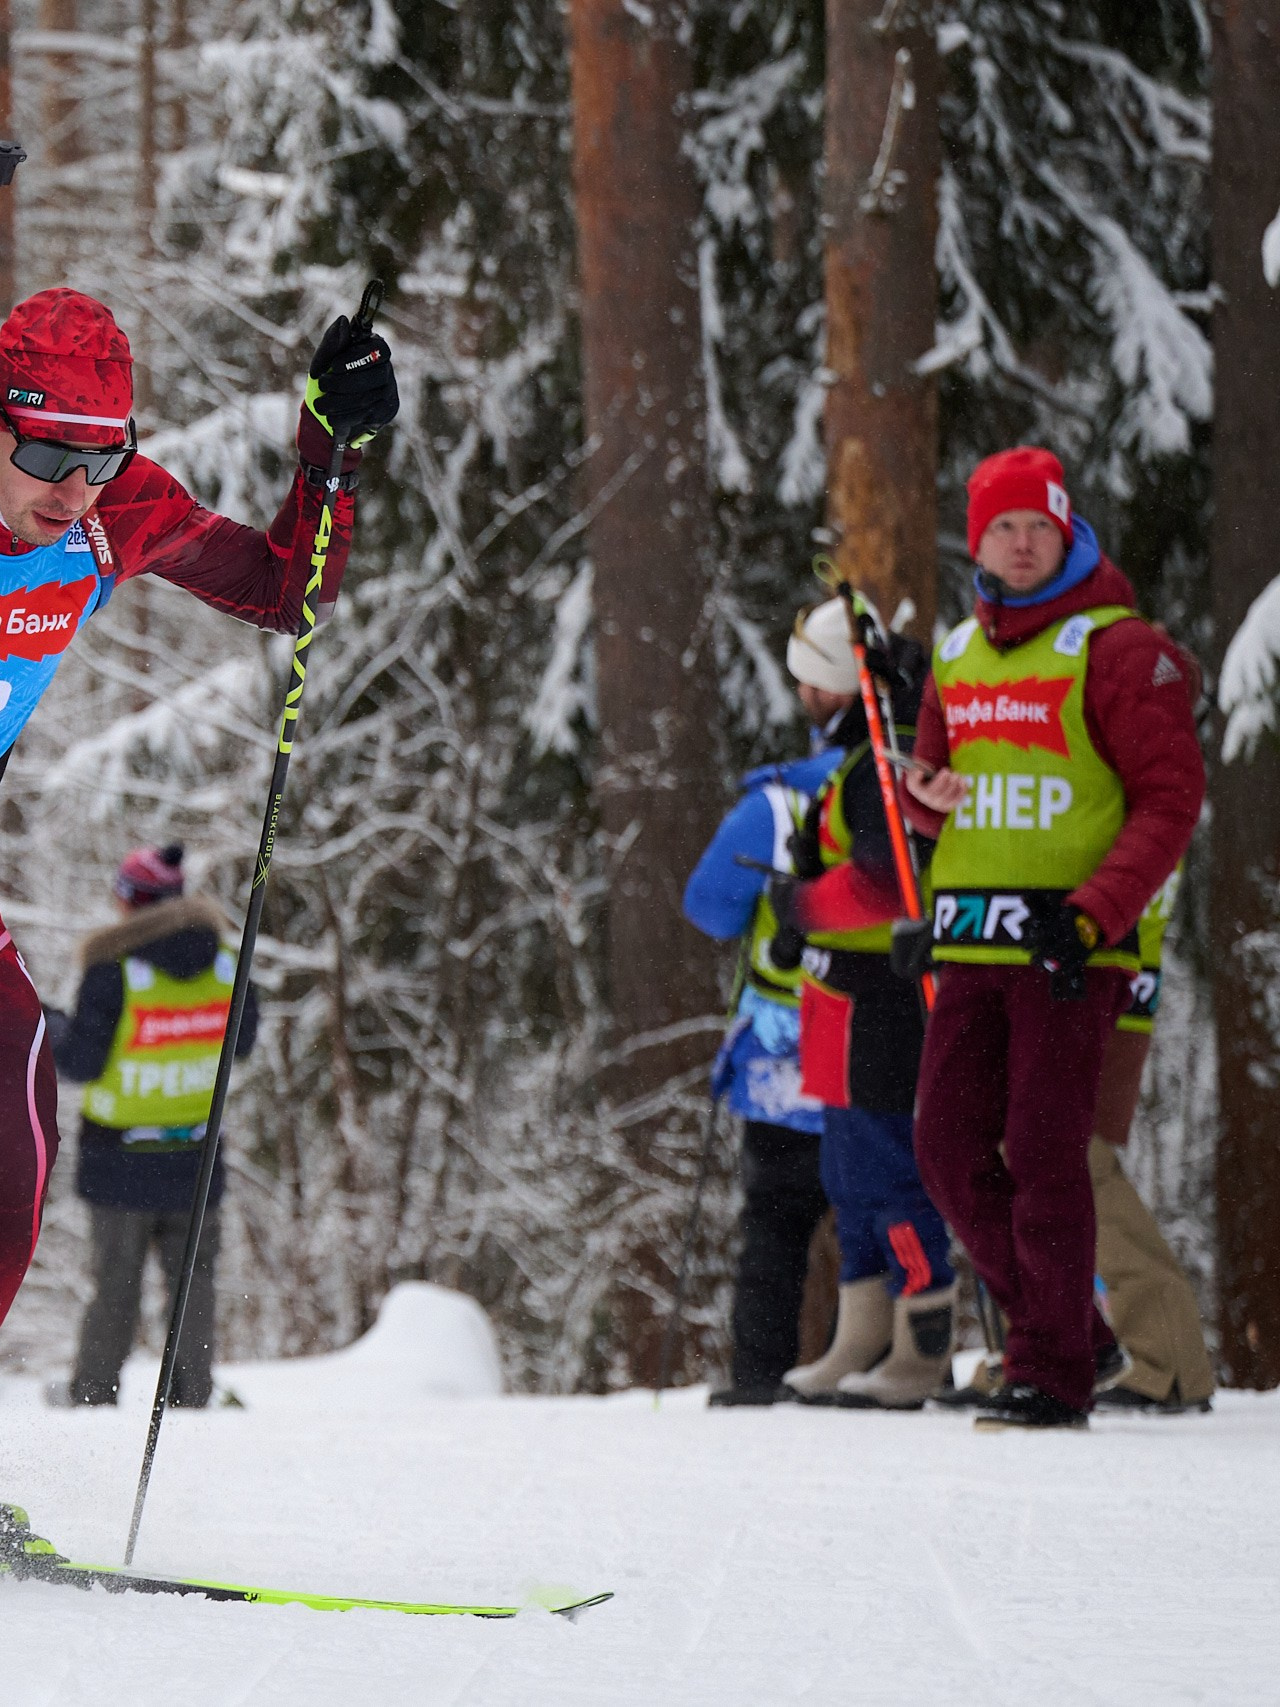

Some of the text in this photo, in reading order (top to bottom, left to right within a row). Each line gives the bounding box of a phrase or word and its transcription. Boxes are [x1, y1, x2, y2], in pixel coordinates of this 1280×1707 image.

[8, 389, 44, 405] PARI
[5, 608, 73, 635] Банк
[946, 695, 1050, 729] льфа Банк
[954, 772, 1074, 831] ЕНЕР
[264, 793, 282, 859] BLACKCODE
[933, 894, 1031, 941] PAR
